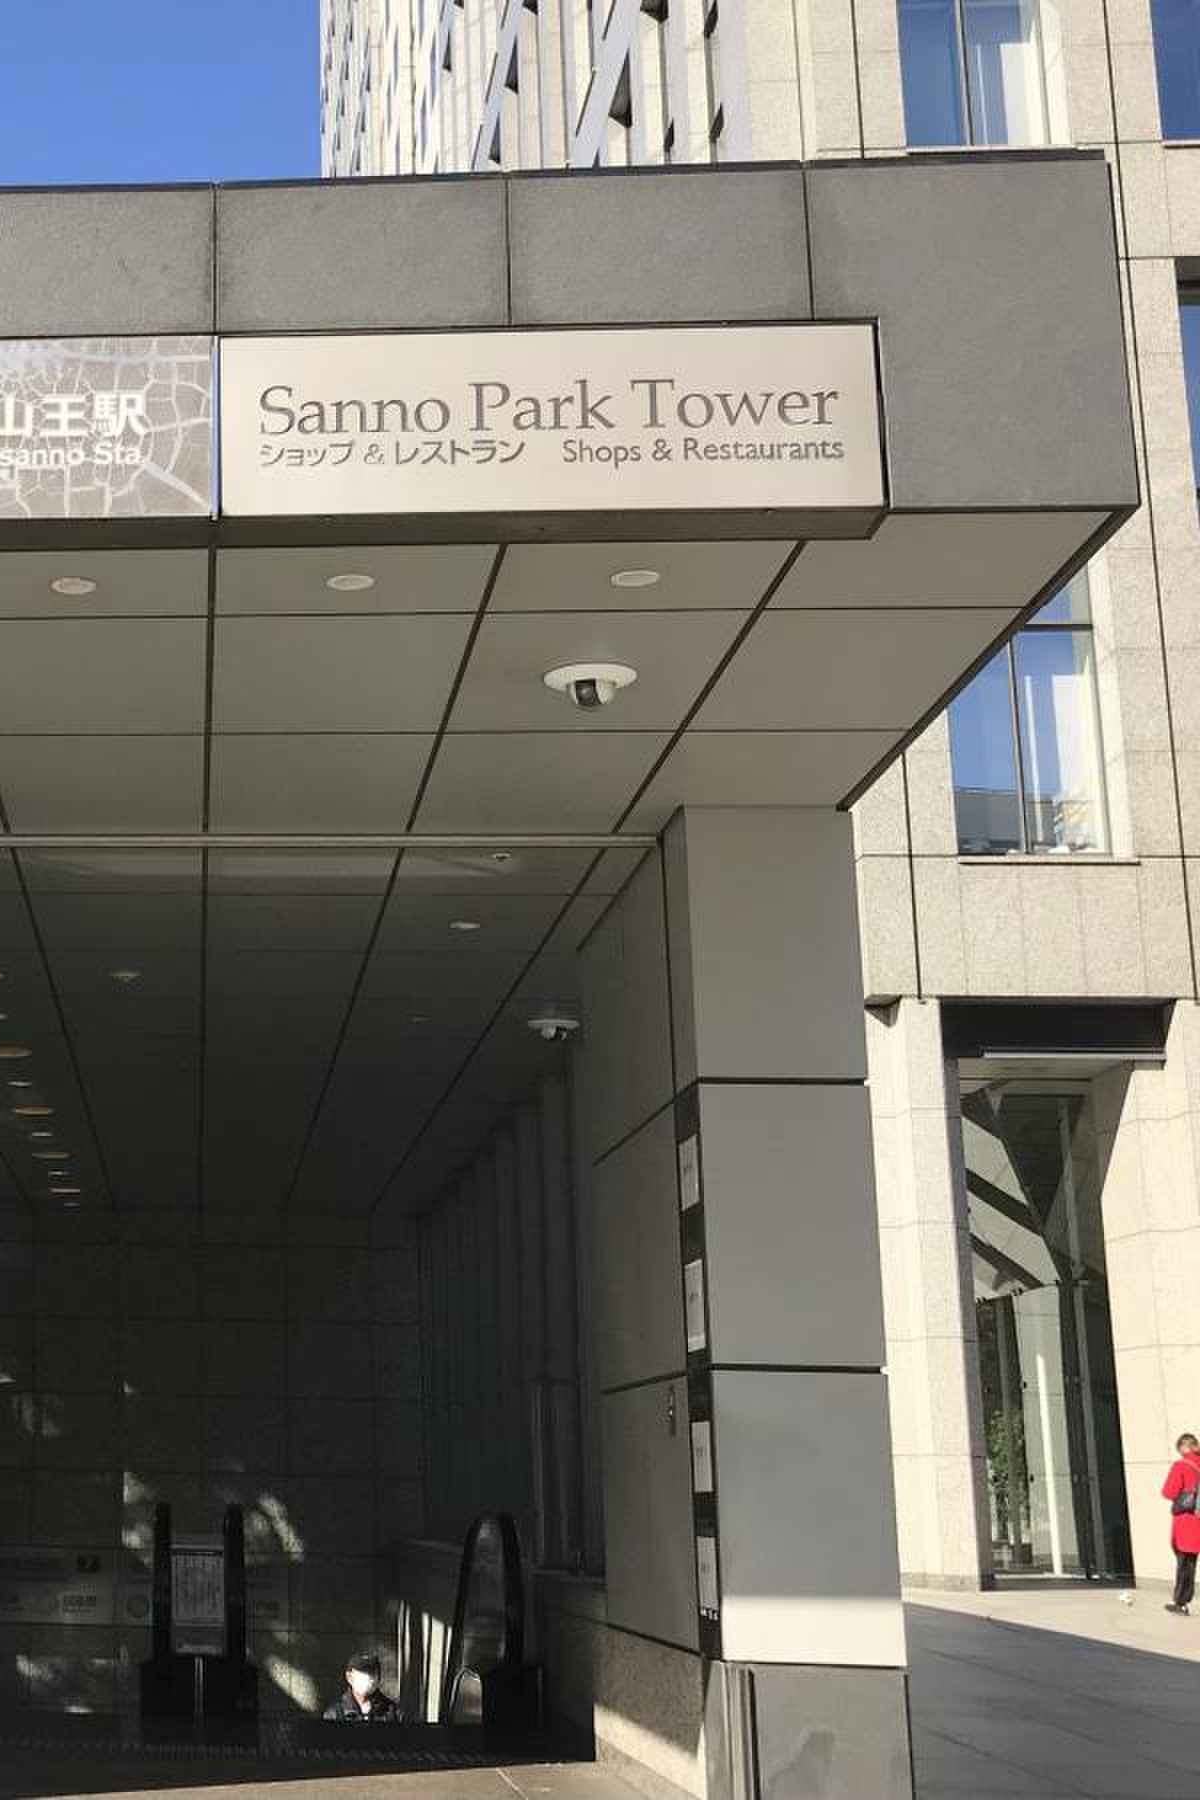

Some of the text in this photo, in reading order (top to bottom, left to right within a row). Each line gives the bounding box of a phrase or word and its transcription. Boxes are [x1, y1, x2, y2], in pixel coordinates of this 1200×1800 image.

[260, 378, 839, 435] Sanno Park Tower
[260, 440, 526, 466] ショップ & レストラン
[562, 437, 845, 470] Shops & Restaurants
